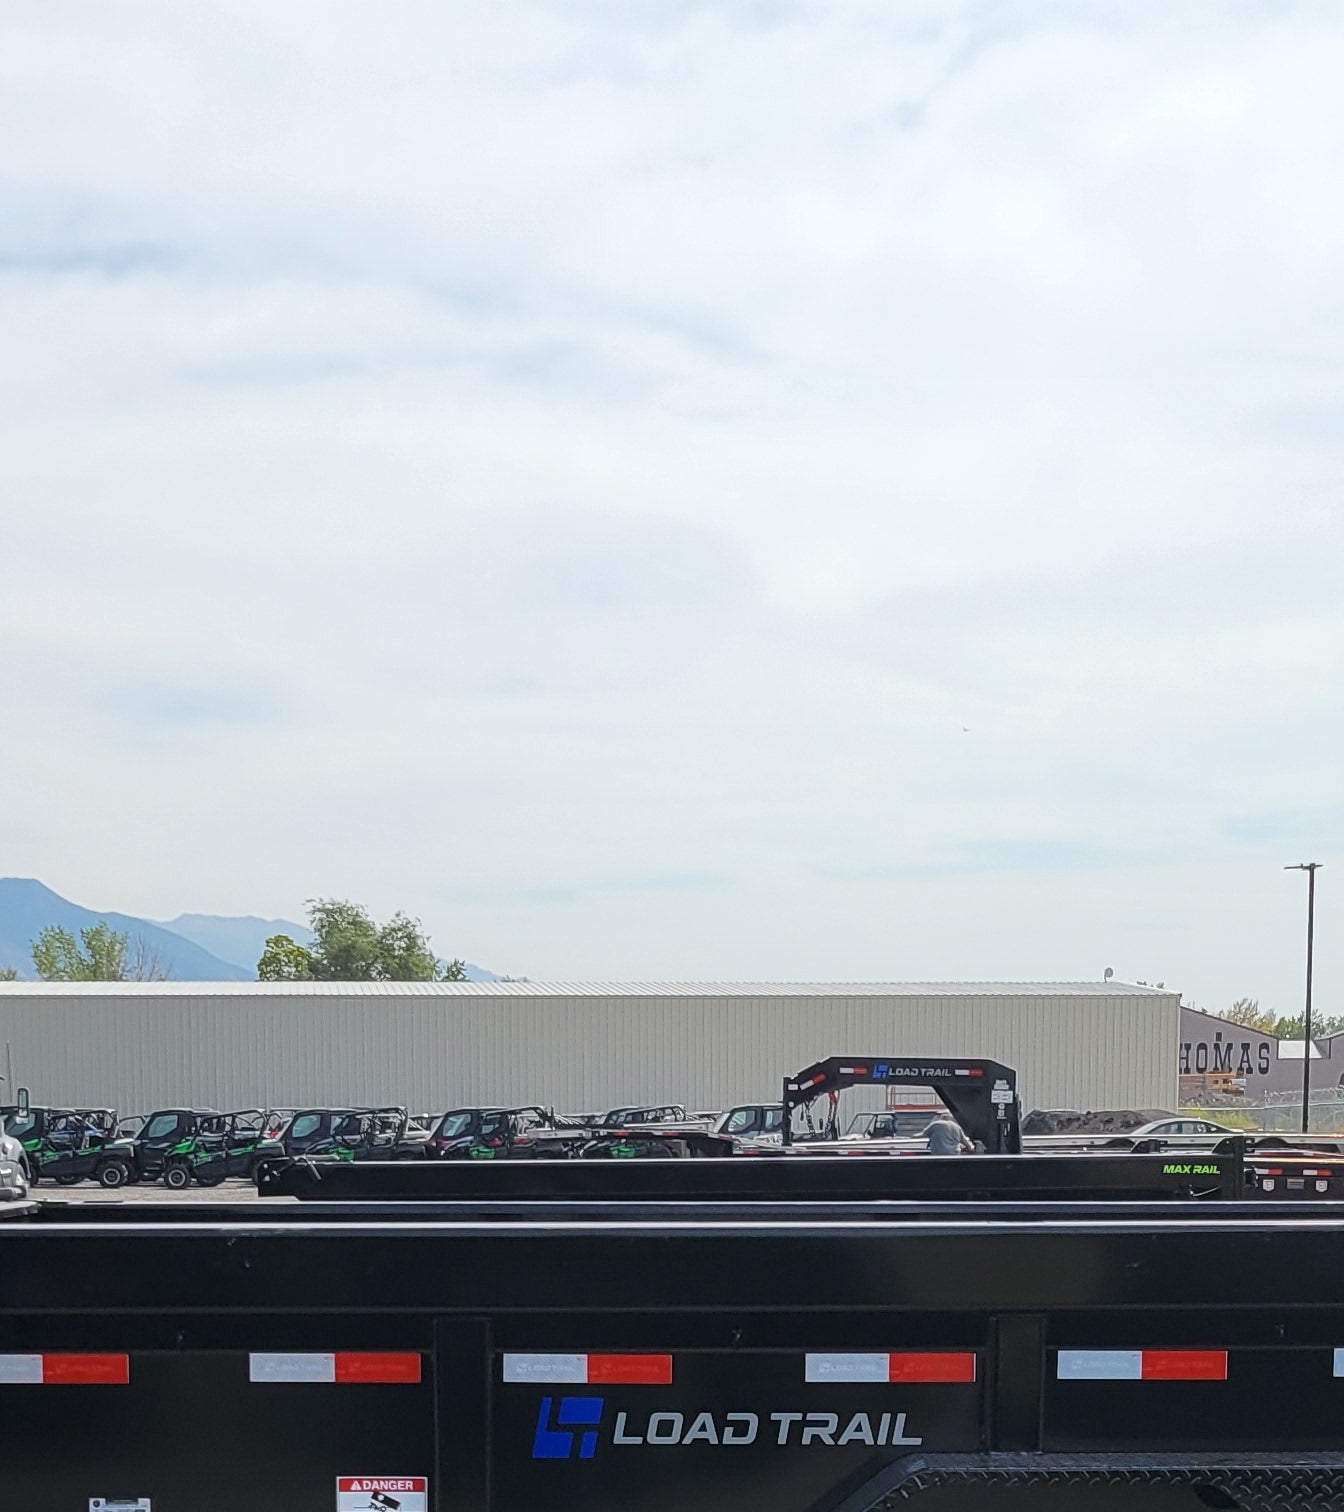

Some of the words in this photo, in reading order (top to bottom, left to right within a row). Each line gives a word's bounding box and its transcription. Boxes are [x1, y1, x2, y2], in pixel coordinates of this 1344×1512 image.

[888, 1067, 919, 1076] LOAD
[920, 1068, 952, 1077] TRAIL
[1163, 1164, 1192, 1174] MAX
[1193, 1165, 1221, 1175] RAIL
[612, 1411, 759, 1446] LOAD
[770, 1412, 924, 1446] TRAIL
[362, 1480, 414, 1491] DANGER
